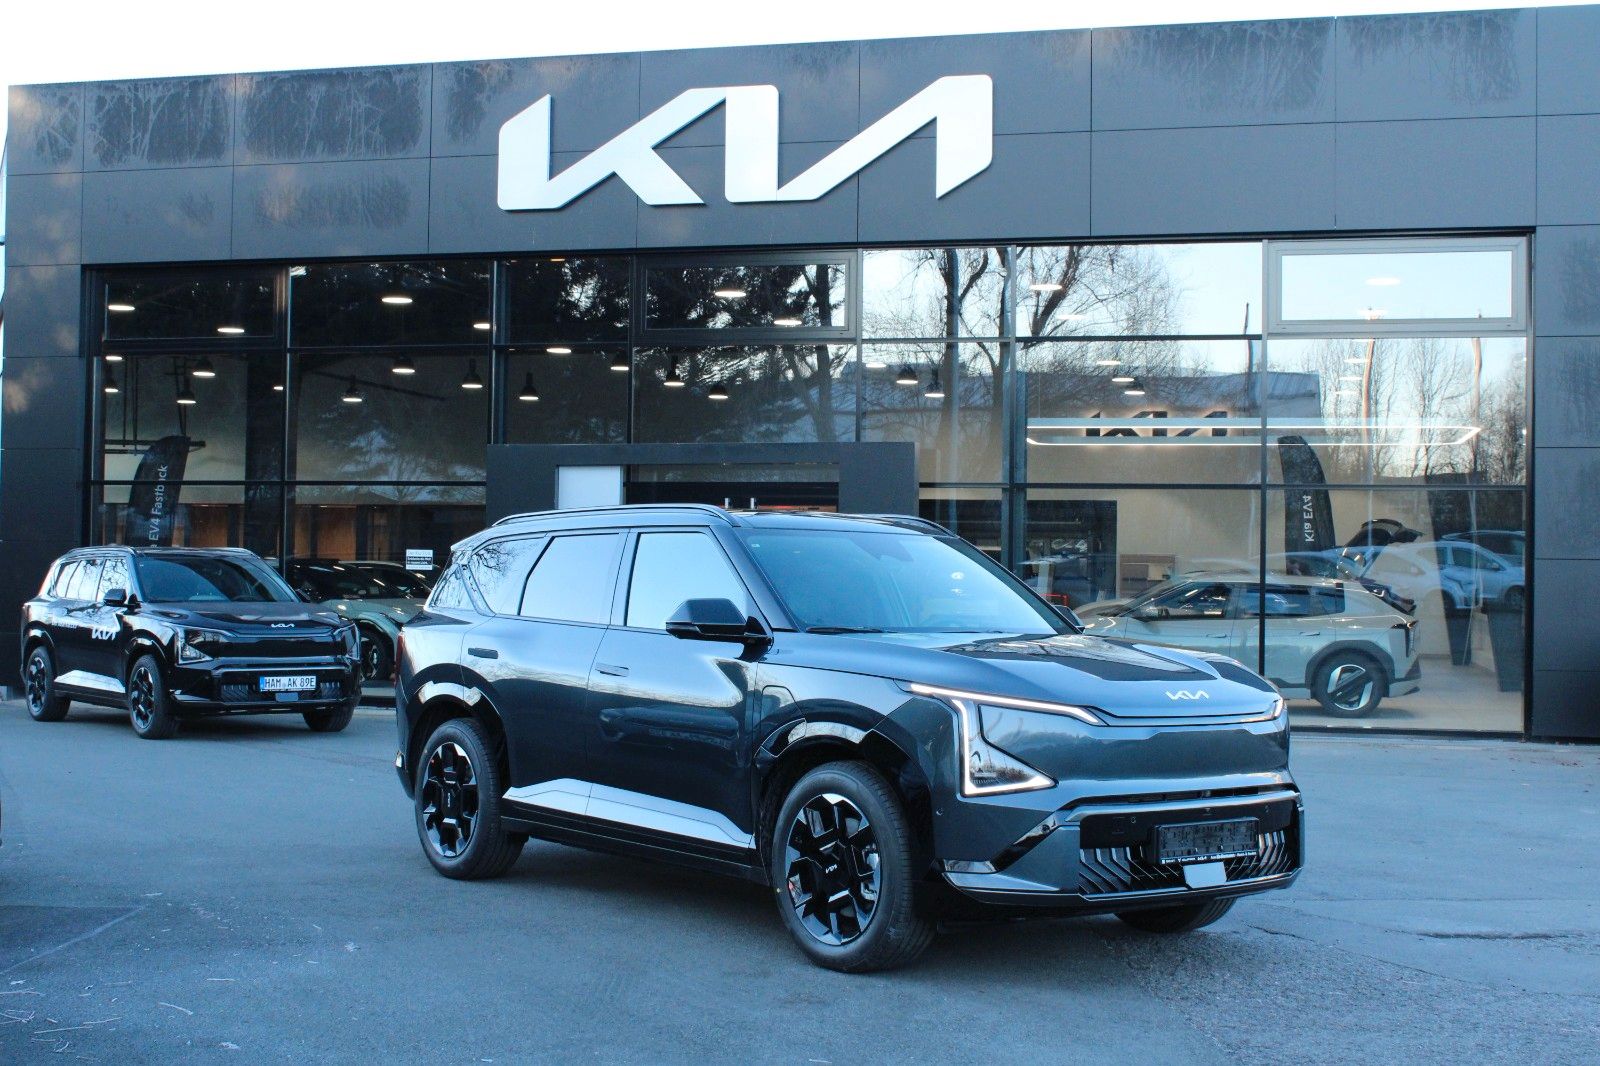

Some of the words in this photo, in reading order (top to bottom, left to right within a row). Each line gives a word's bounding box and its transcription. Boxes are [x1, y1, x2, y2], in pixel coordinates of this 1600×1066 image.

[497, 74, 993, 210] KIA
[149, 517, 160, 541] EV4
[265, 678, 281, 688] HAM
[287, 677, 298, 687] AK
[300, 677, 315, 687] 89E
[1165, 690, 1210, 700] KIA
